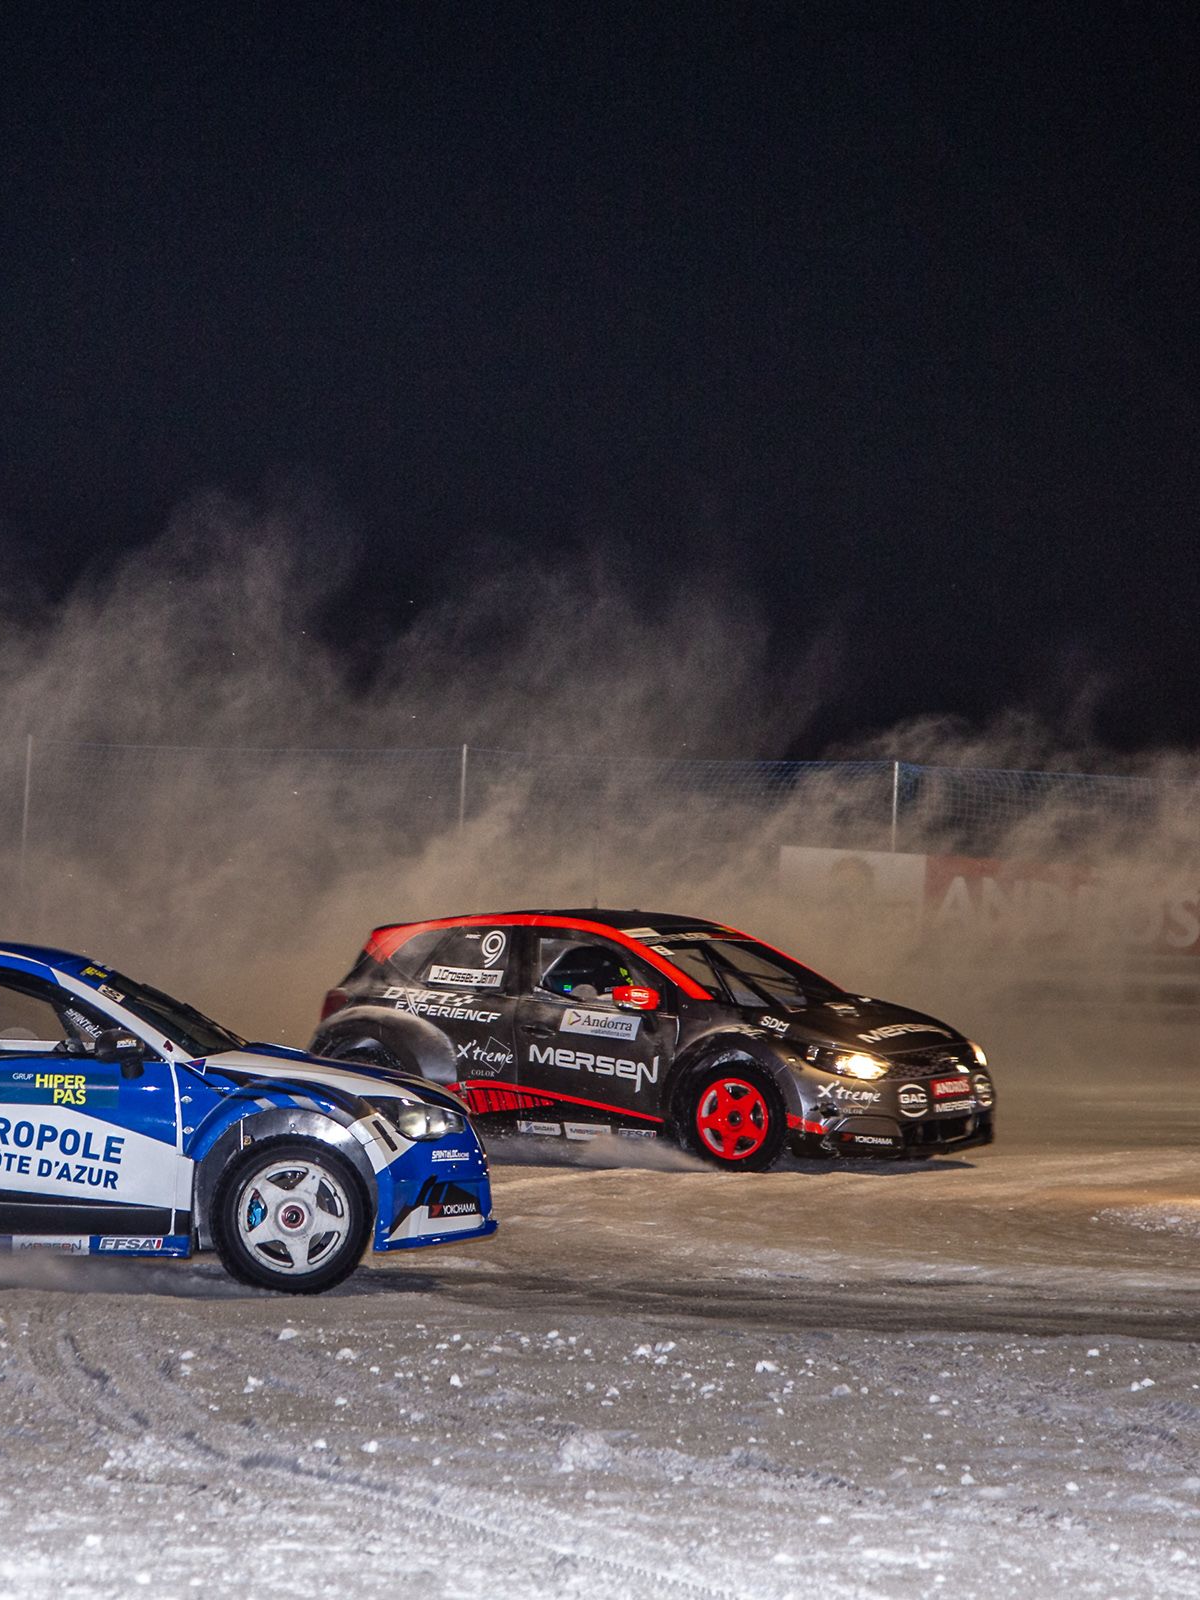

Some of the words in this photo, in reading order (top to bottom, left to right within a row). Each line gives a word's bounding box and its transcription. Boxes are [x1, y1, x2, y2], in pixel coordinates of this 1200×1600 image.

[481, 930, 506, 968] 9
[382, 987, 458, 1005] DRIFT
[582, 1015, 632, 1031] Andorra
[760, 1015, 790, 1032] SDM
[12, 1072, 34, 1081] GRUP
[35, 1073, 86, 1090] HIPER
[471, 1069, 495, 1077] COLOR
[53, 1089, 87, 1105] PAS
[854, 1135, 893, 1145] YOKOHAMA
[37, 1159, 119, 1190] D'AZUR
[443, 1203, 477, 1215] YOKOHAMA
